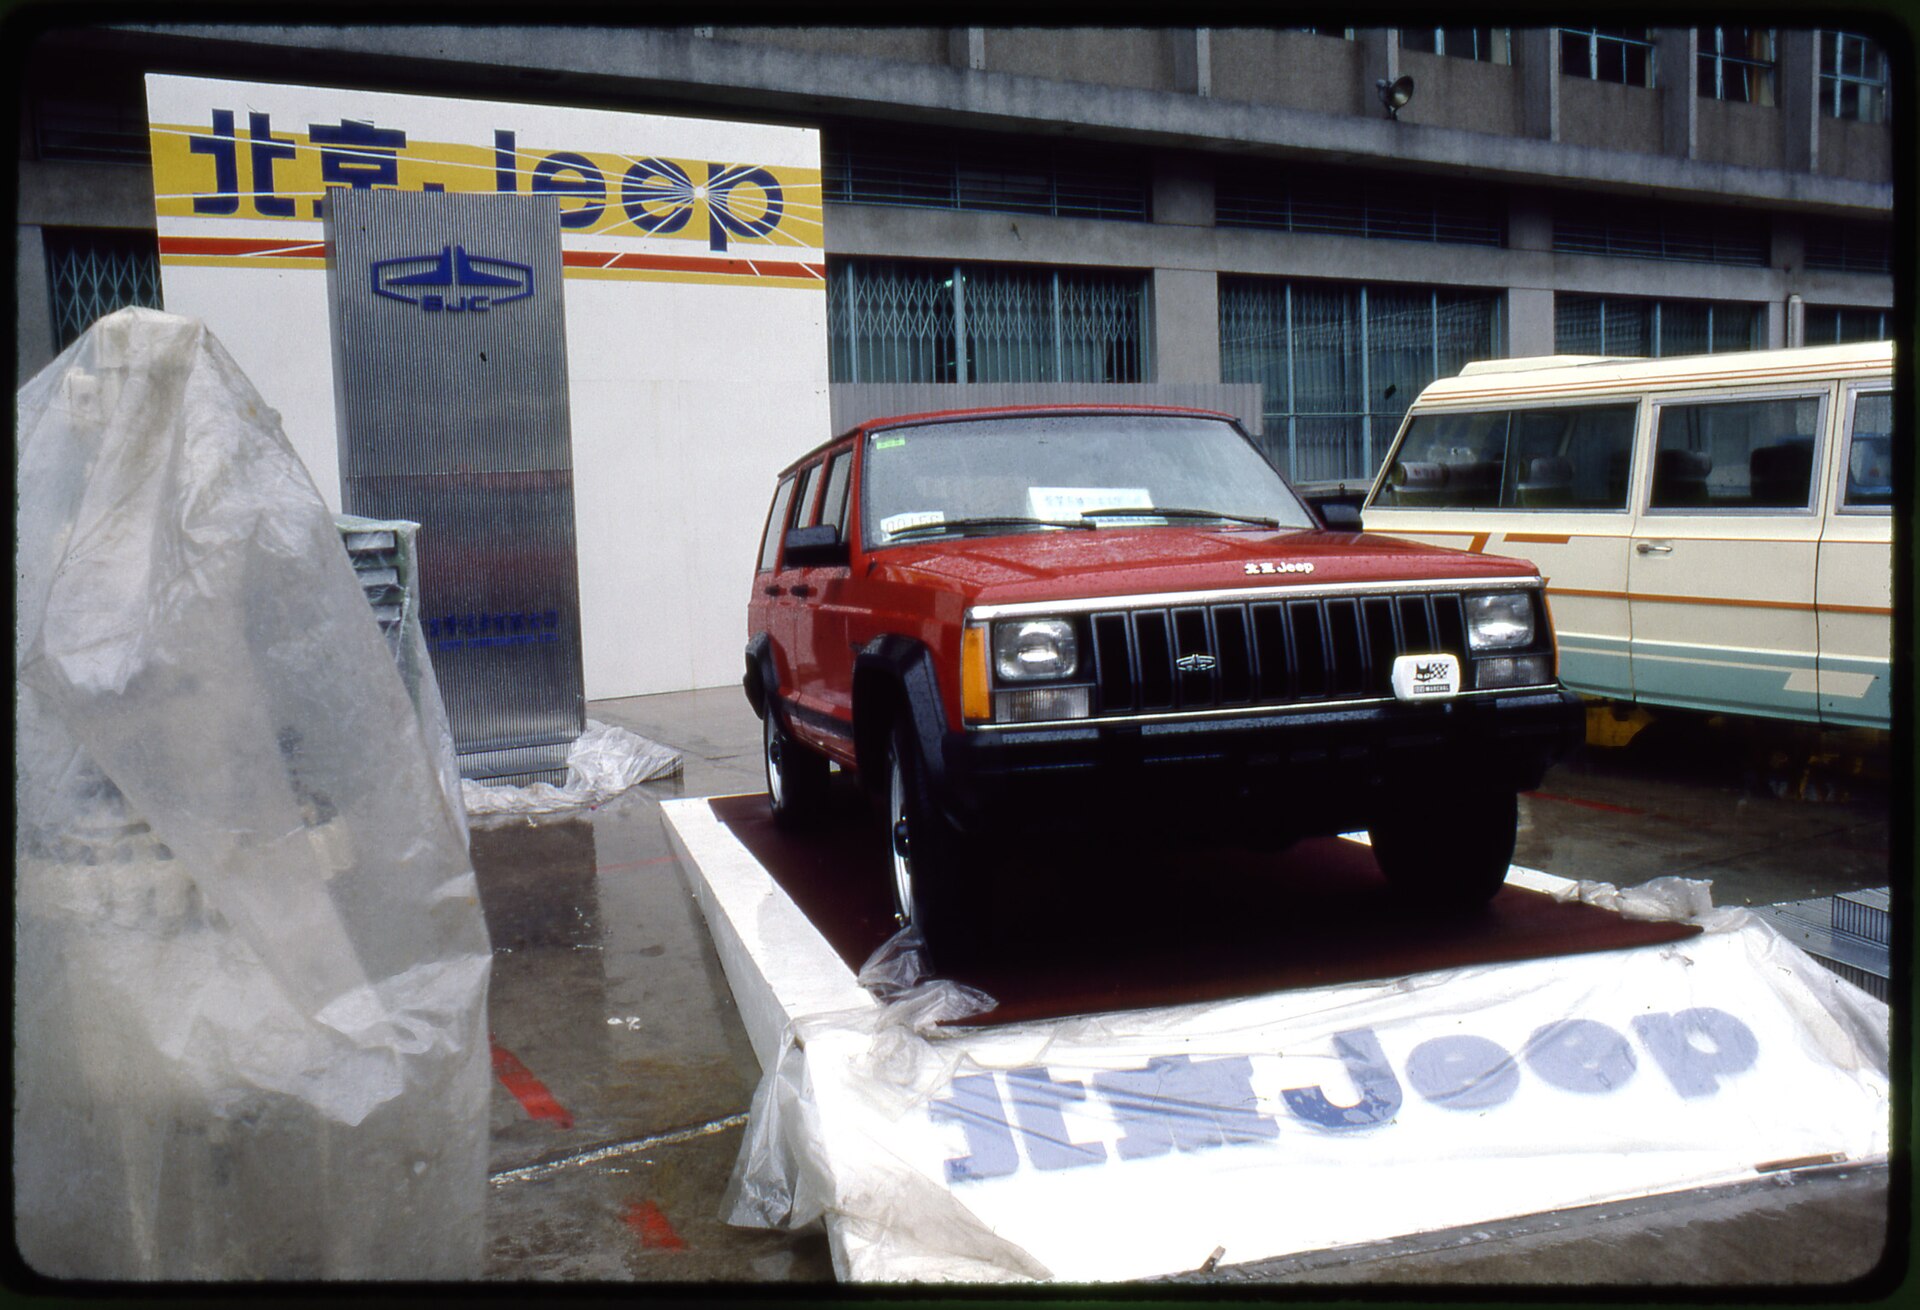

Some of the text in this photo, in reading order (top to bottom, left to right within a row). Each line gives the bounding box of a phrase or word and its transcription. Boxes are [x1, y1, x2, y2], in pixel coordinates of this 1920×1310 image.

[423, 294, 490, 311] BJC
[1276, 561, 1315, 574] Jeep
[1280, 1006, 1760, 1128] Jeep
